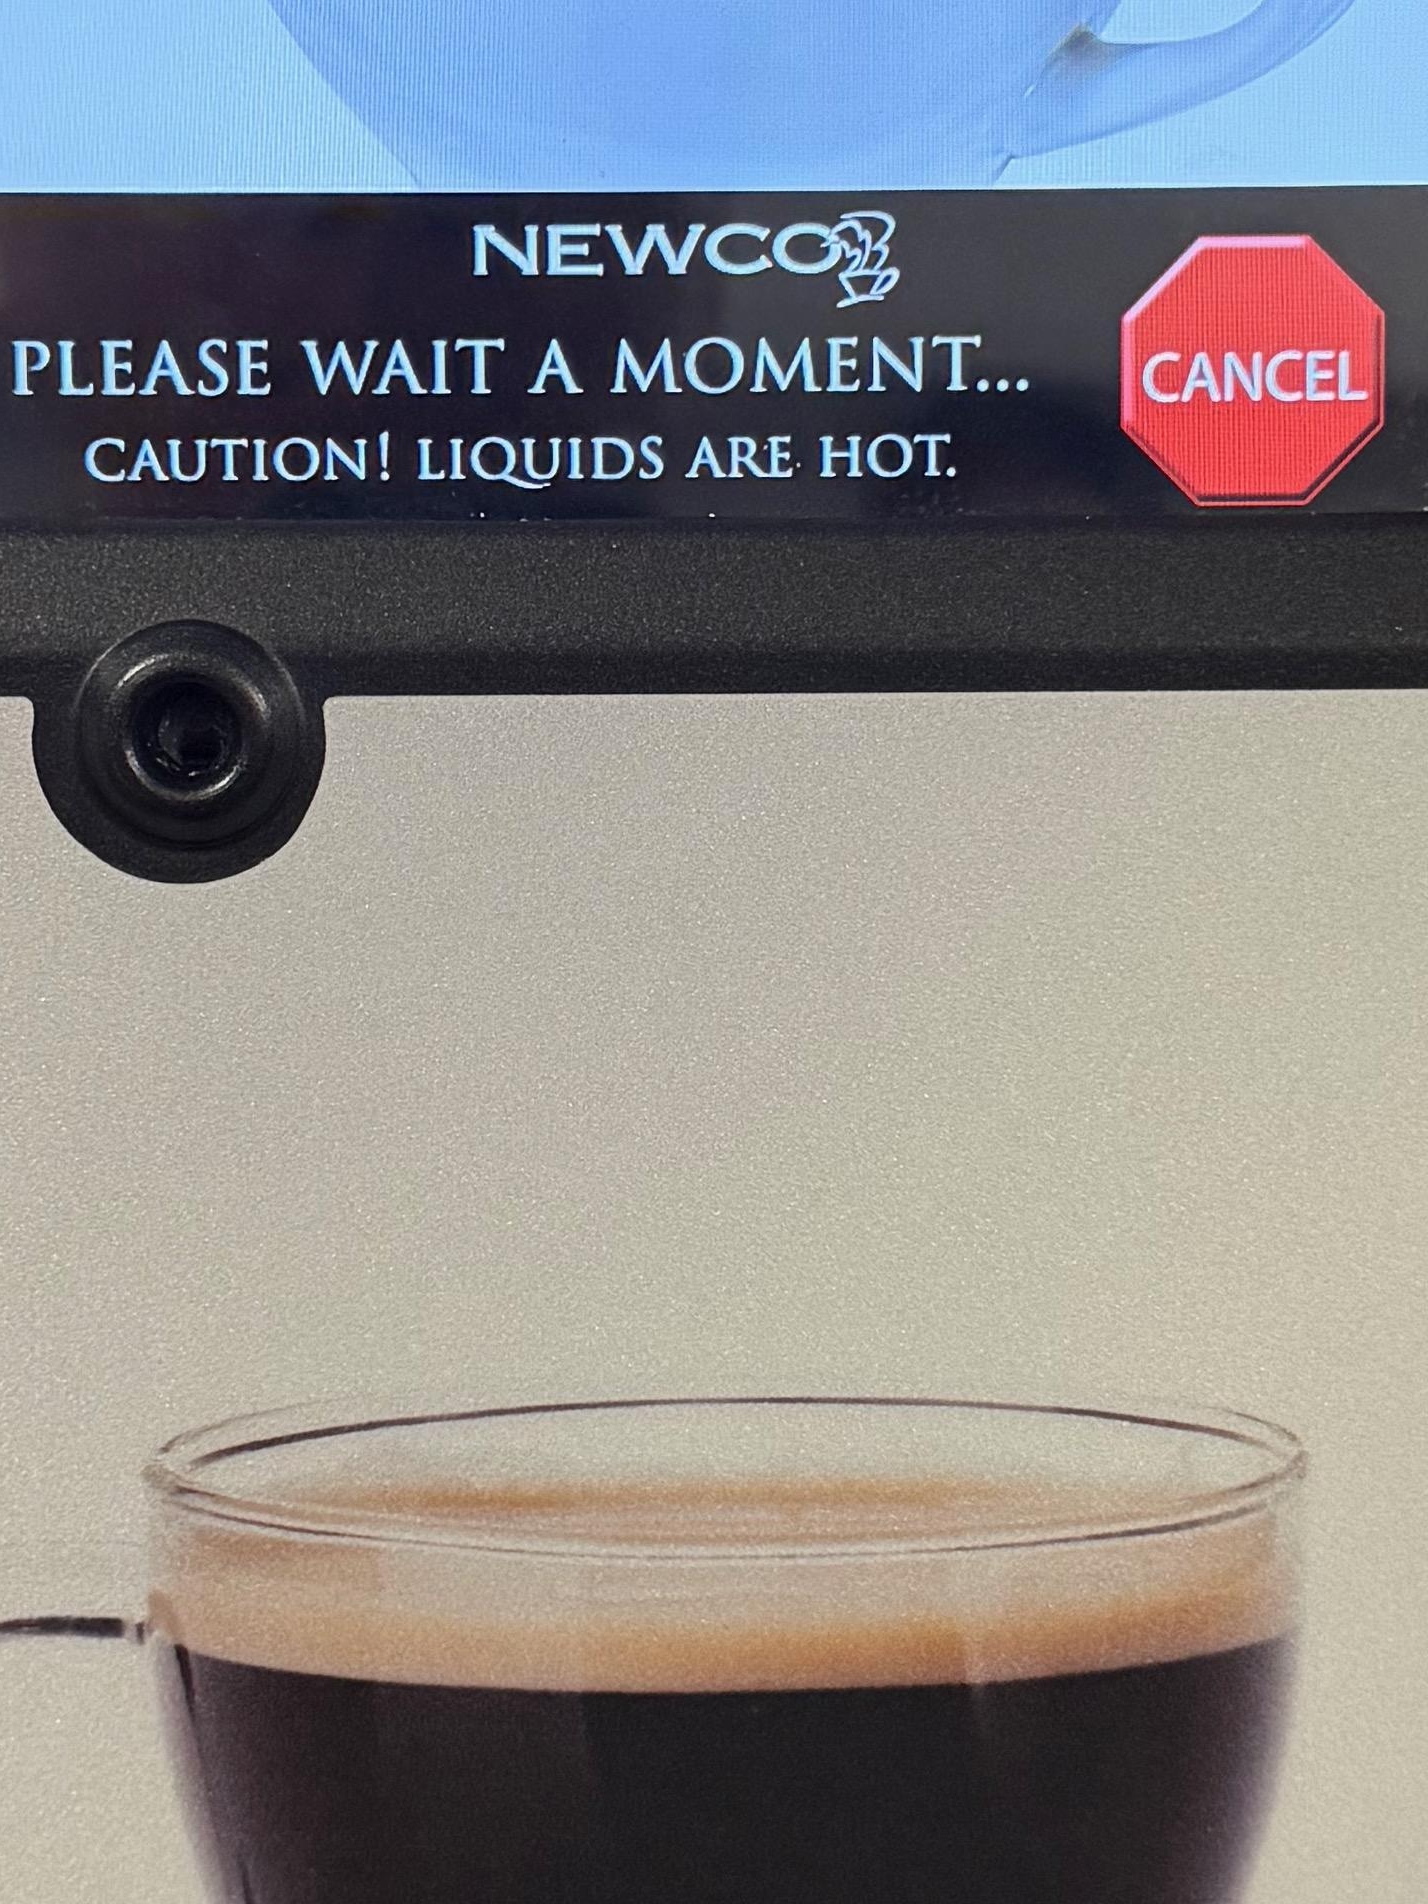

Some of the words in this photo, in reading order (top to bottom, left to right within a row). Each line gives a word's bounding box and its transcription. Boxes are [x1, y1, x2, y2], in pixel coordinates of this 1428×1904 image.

[472, 221, 836, 277] NEWCO
[11, 337, 272, 398] PLEASE
[300, 337, 506, 397] WAIT
[526, 337, 585, 395] A
[610, 334, 1030, 395] MOMENT...
[1141, 349, 1369, 404] CANCEL
[83, 431, 391, 483] CAUTION!
[417, 434, 665, 491] LIQUIDS
[684, 435, 793, 479] ARE
[819, 432, 958, 479] HOT.
